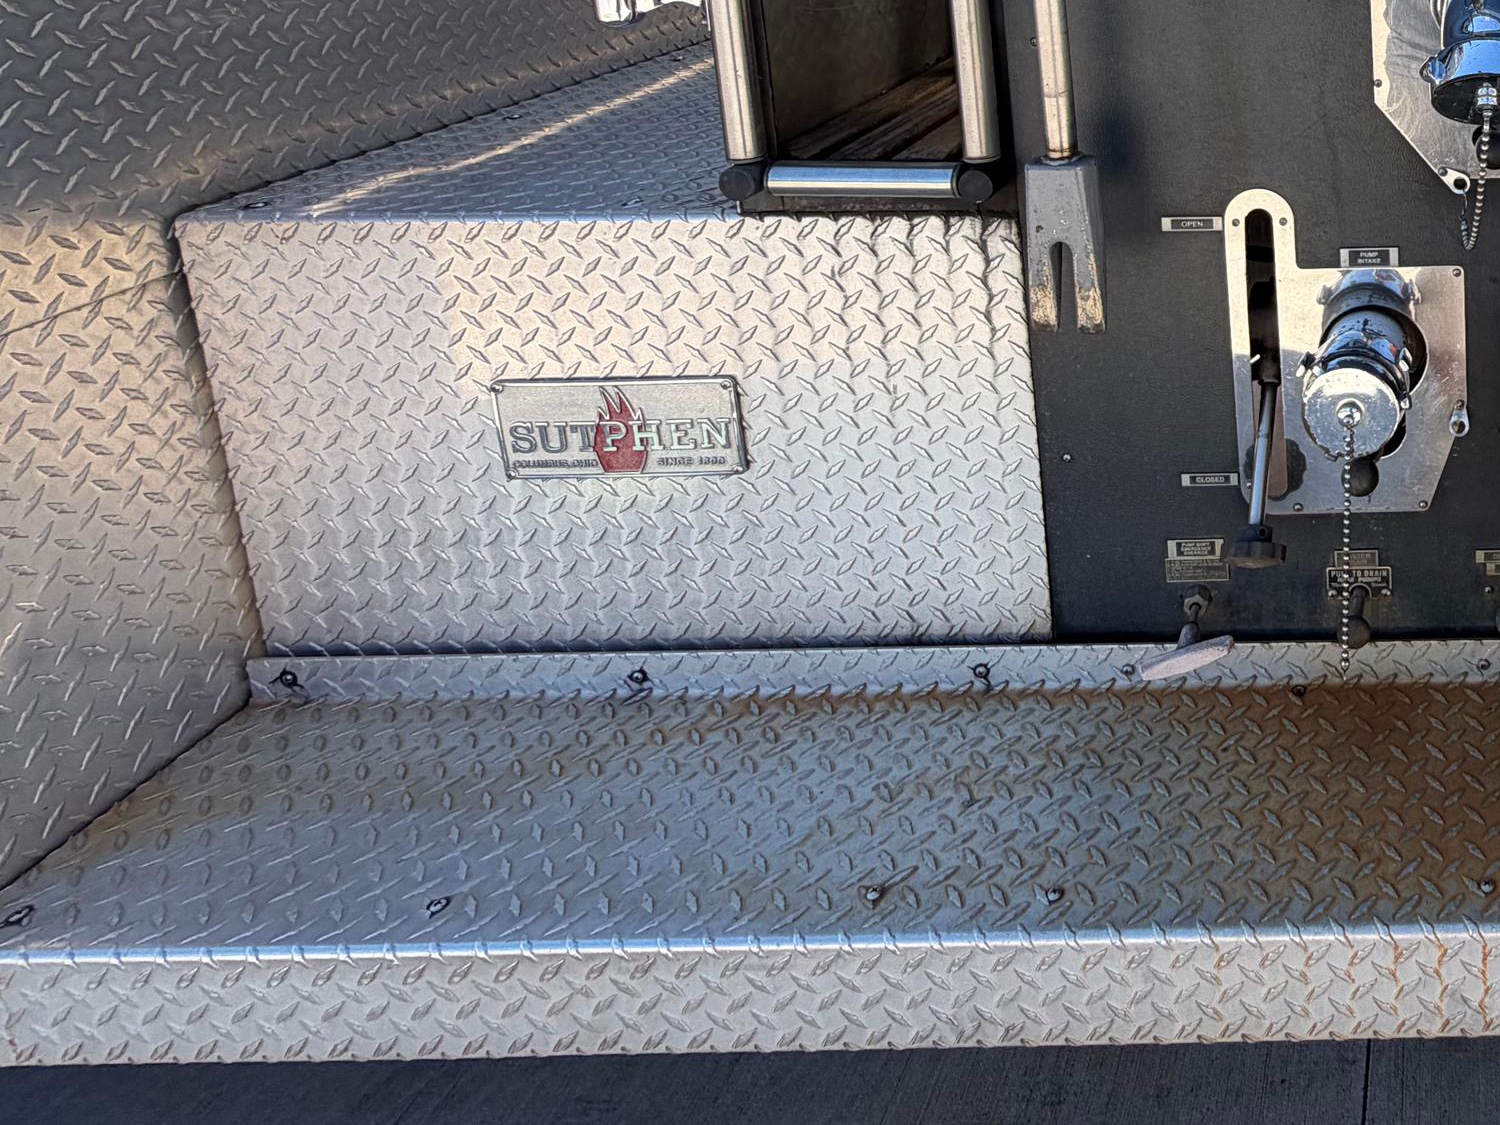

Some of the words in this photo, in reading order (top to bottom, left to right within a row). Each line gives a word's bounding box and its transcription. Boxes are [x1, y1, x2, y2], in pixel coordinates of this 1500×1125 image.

[1181, 220, 1204, 228] OPEN
[509, 417, 732, 454] SUTPHEN
[656, 456, 694, 467] SINCE
